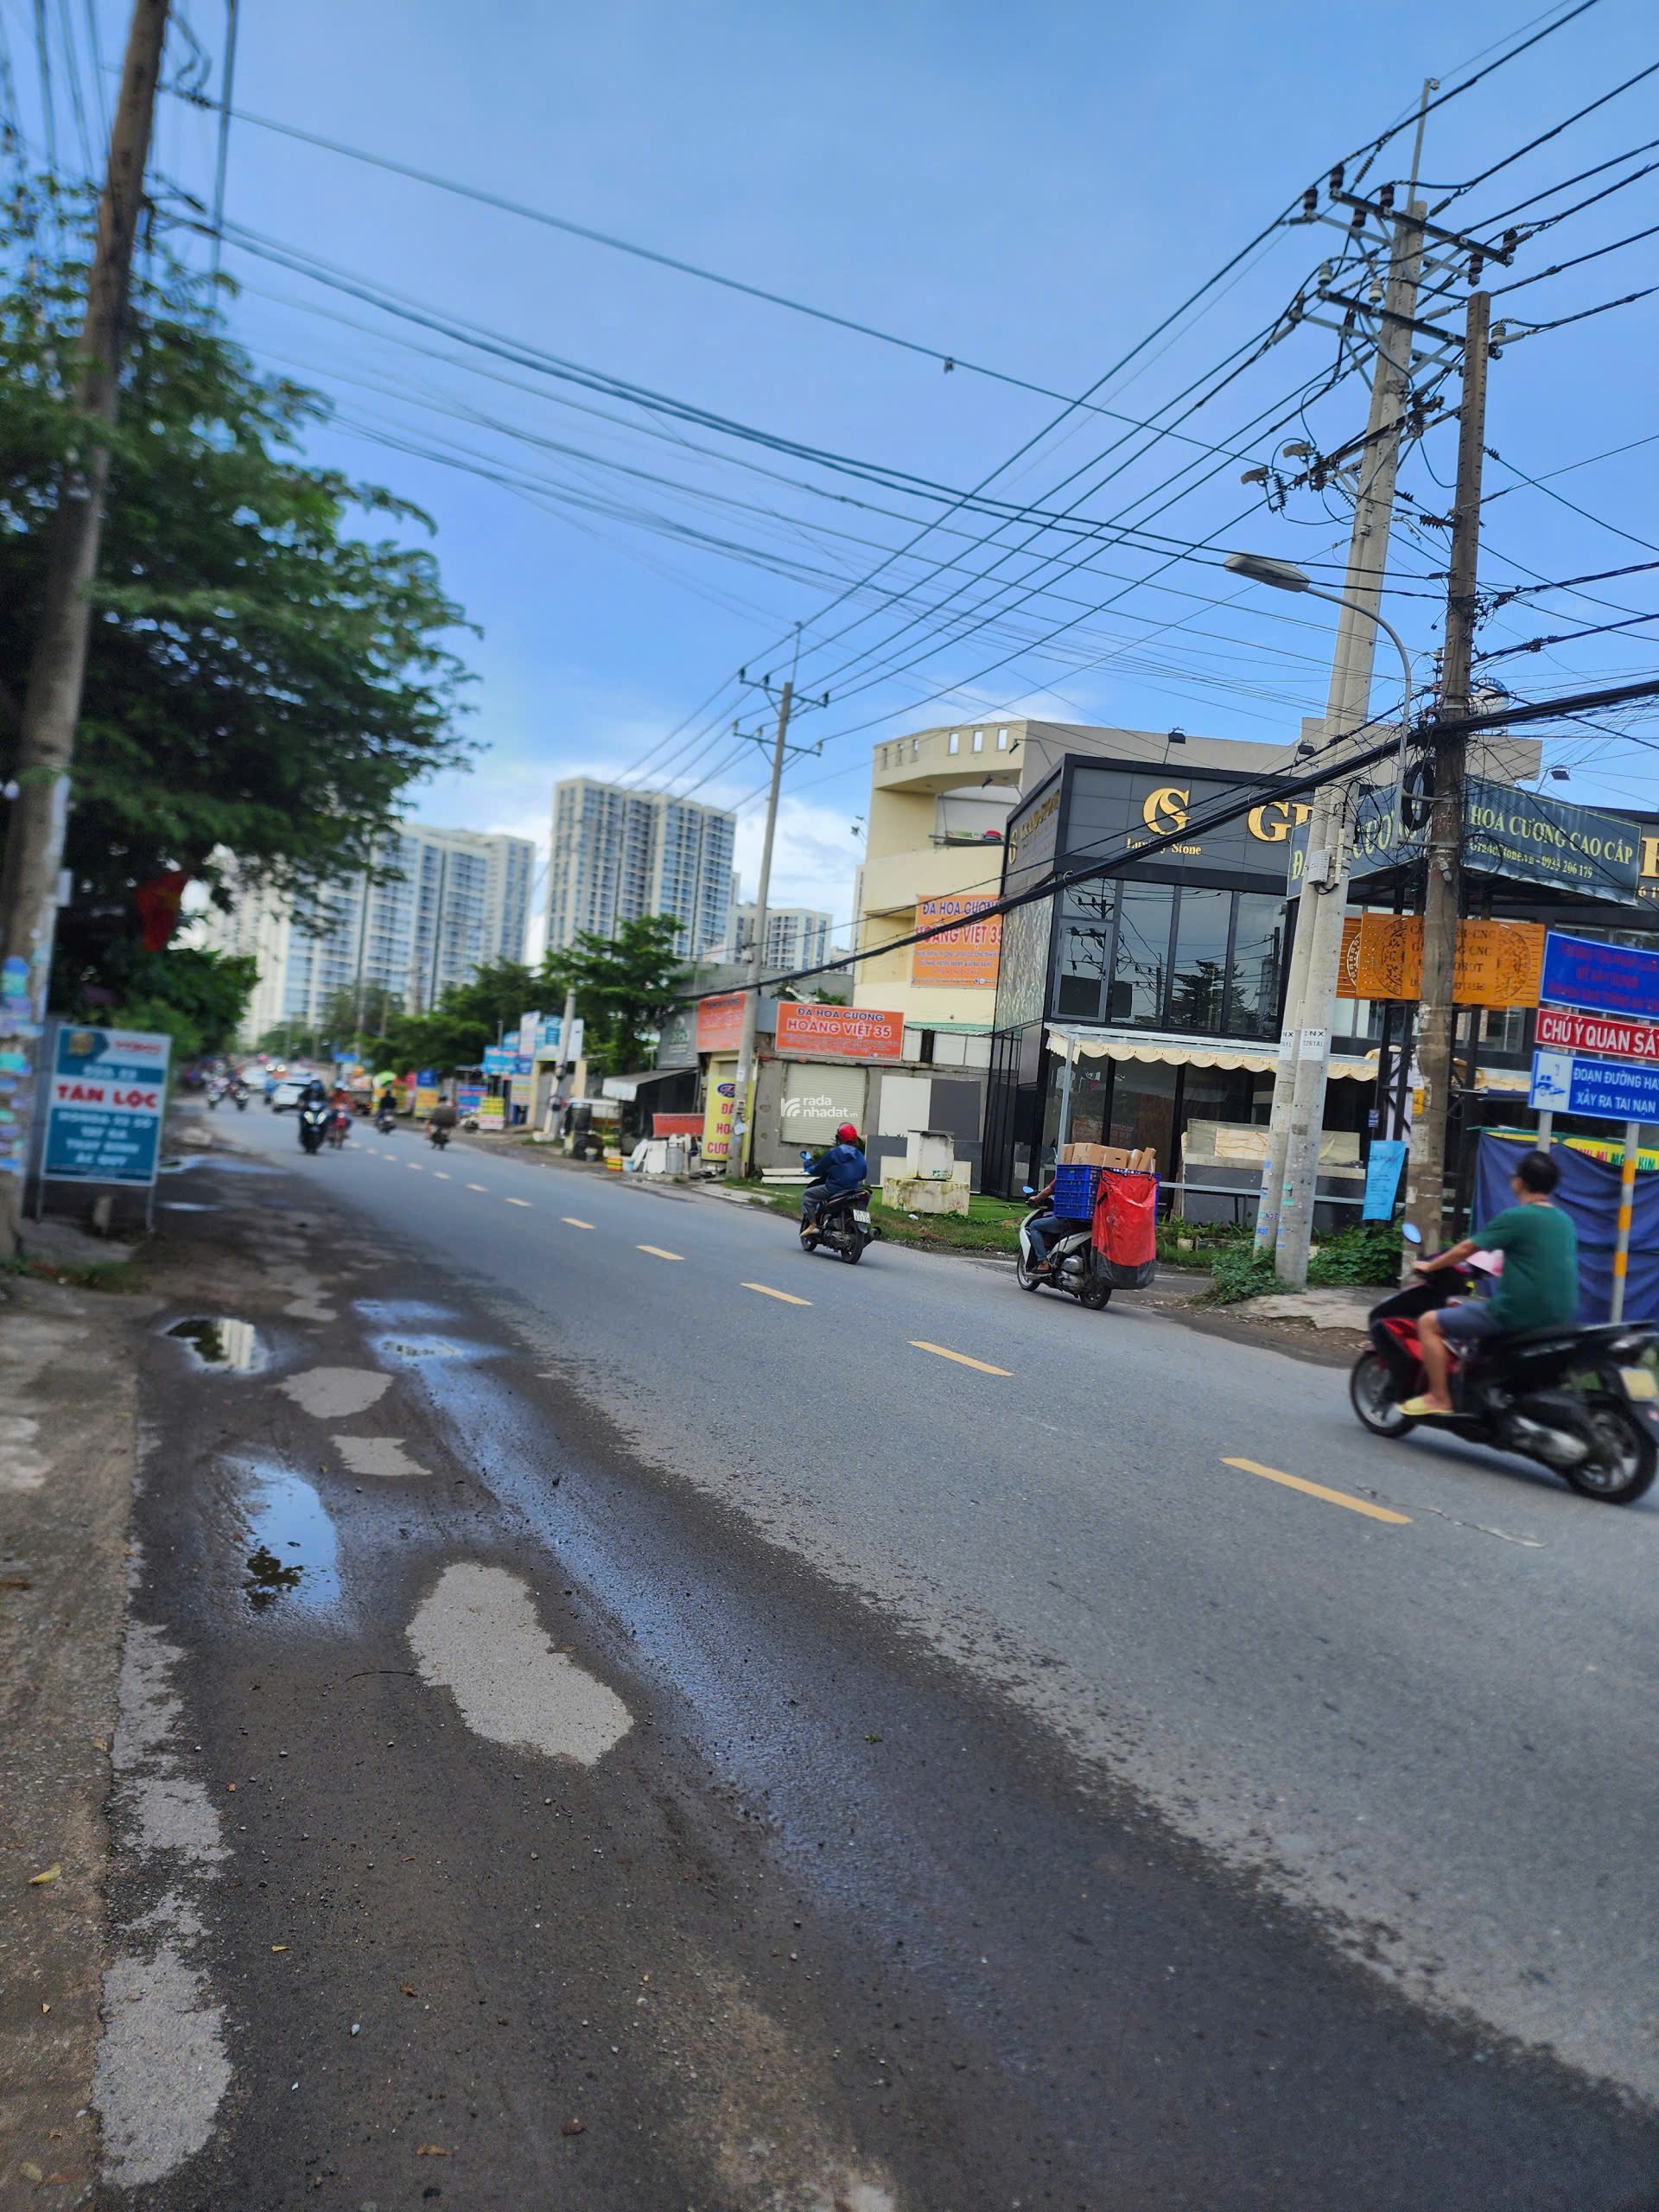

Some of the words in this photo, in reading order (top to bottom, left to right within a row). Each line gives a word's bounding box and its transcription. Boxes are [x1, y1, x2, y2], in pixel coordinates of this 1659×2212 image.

[1171, 843, 1202, 855] Stone
[1569, 831, 1602, 857] CAO
[1604, 839, 1633, 864] CẤP
[939, 901, 961, 916] HOA
[798, 1007, 812, 1016] ĐÁ
[816, 1009, 840, 1019] HOA
[842, 1012, 885, 1022] CƯƠNG
[787, 1018, 839, 1034] HOÀNG
[843, 1020, 871, 1039] VIỆT
[874, 1027, 892, 1038] 35
[1542, 1016, 1572, 1043] CHÚ
[1574, 1018, 1585, 1045] Ý
[1585, 1026, 1630, 1052] QUAN
[1632, 1027, 1659, 1055] SÁ
[1573, 1068, 1603, 1085] ĐOẠN
[1604, 1071, 1642, 1088] ĐƯỜNG
[1576, 1089, 1598, 1107] XẢY
[1599, 1095, 1613, 1108] RA
[1615, 1097, 1631, 1111] TAI
[1632, 1100, 1656, 1116] NẠN
[715, 1123, 731, 1135] HO
